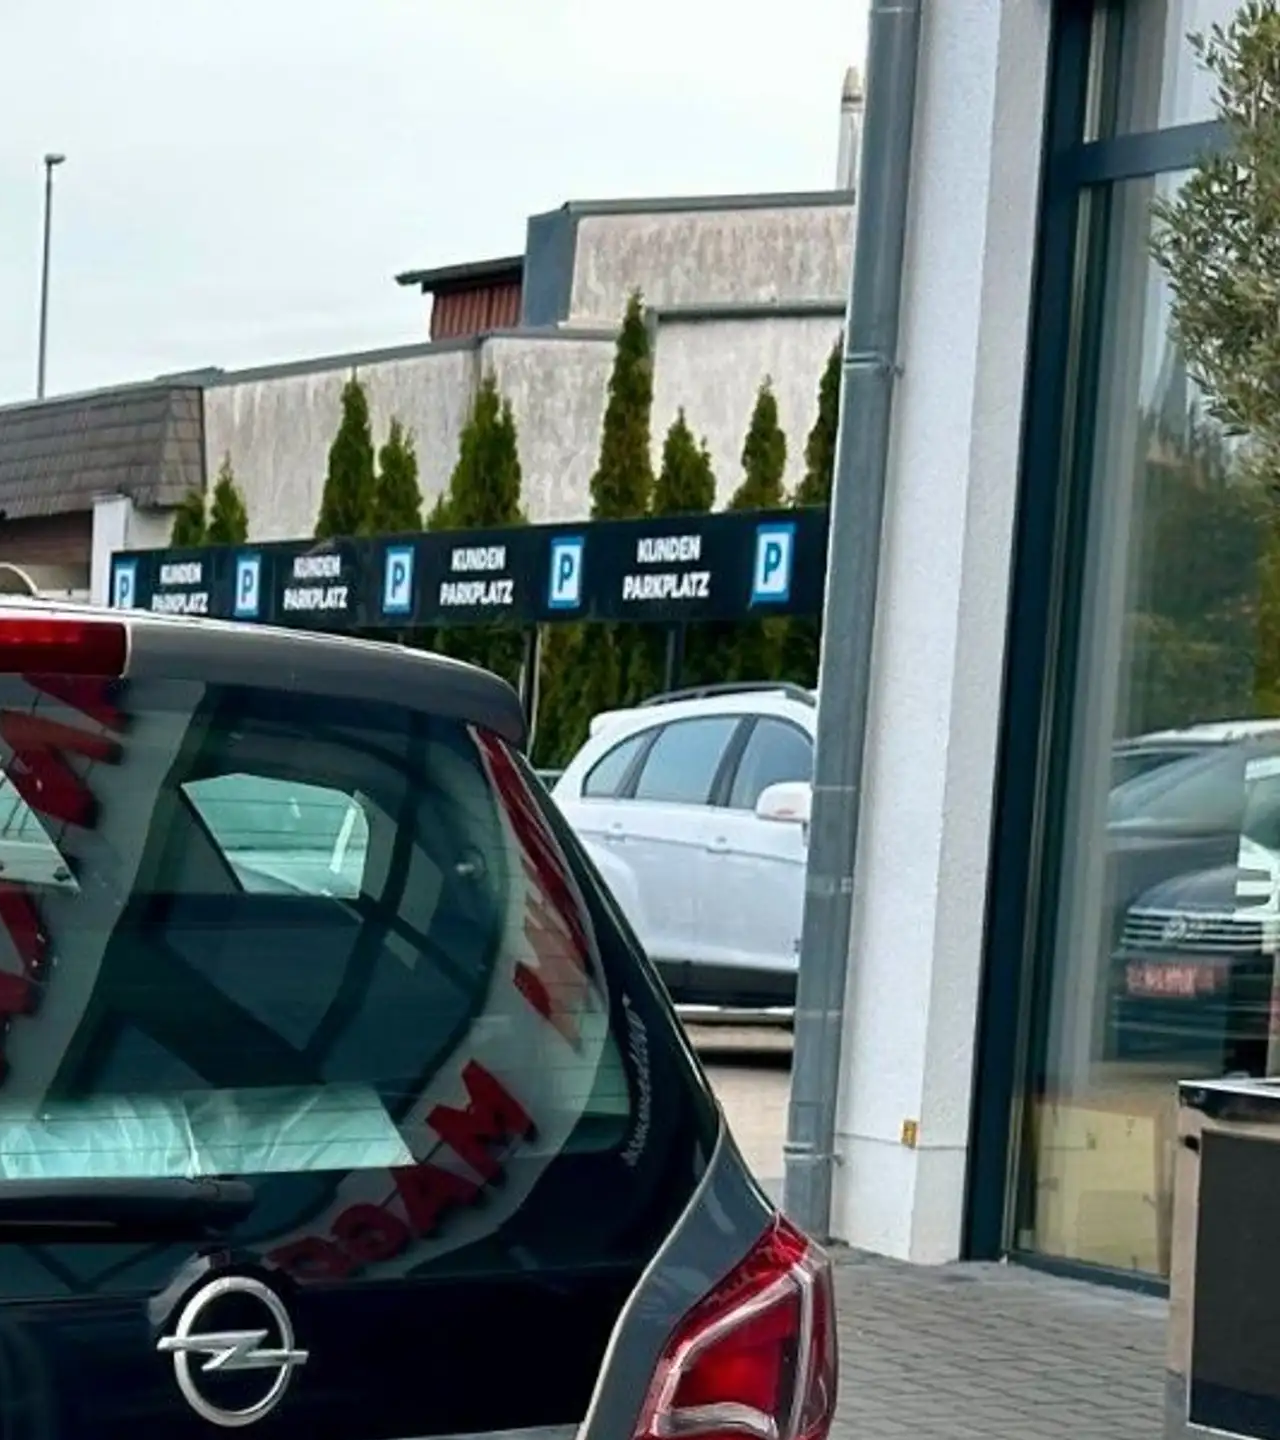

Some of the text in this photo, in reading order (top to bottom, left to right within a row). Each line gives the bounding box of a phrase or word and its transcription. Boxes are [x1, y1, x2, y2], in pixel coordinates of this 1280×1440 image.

[451, 546, 507, 572] KUNDEN
[636, 534, 702, 563] KUNDEN
[159, 561, 202, 585] KUNDEN
[293, 553, 341, 578] KUNDEN
[440, 579, 514, 606] PARKPLATZ
[622, 570, 711, 600] PARKPLATZ
[283, 586, 348, 611] PARKPLATZ
